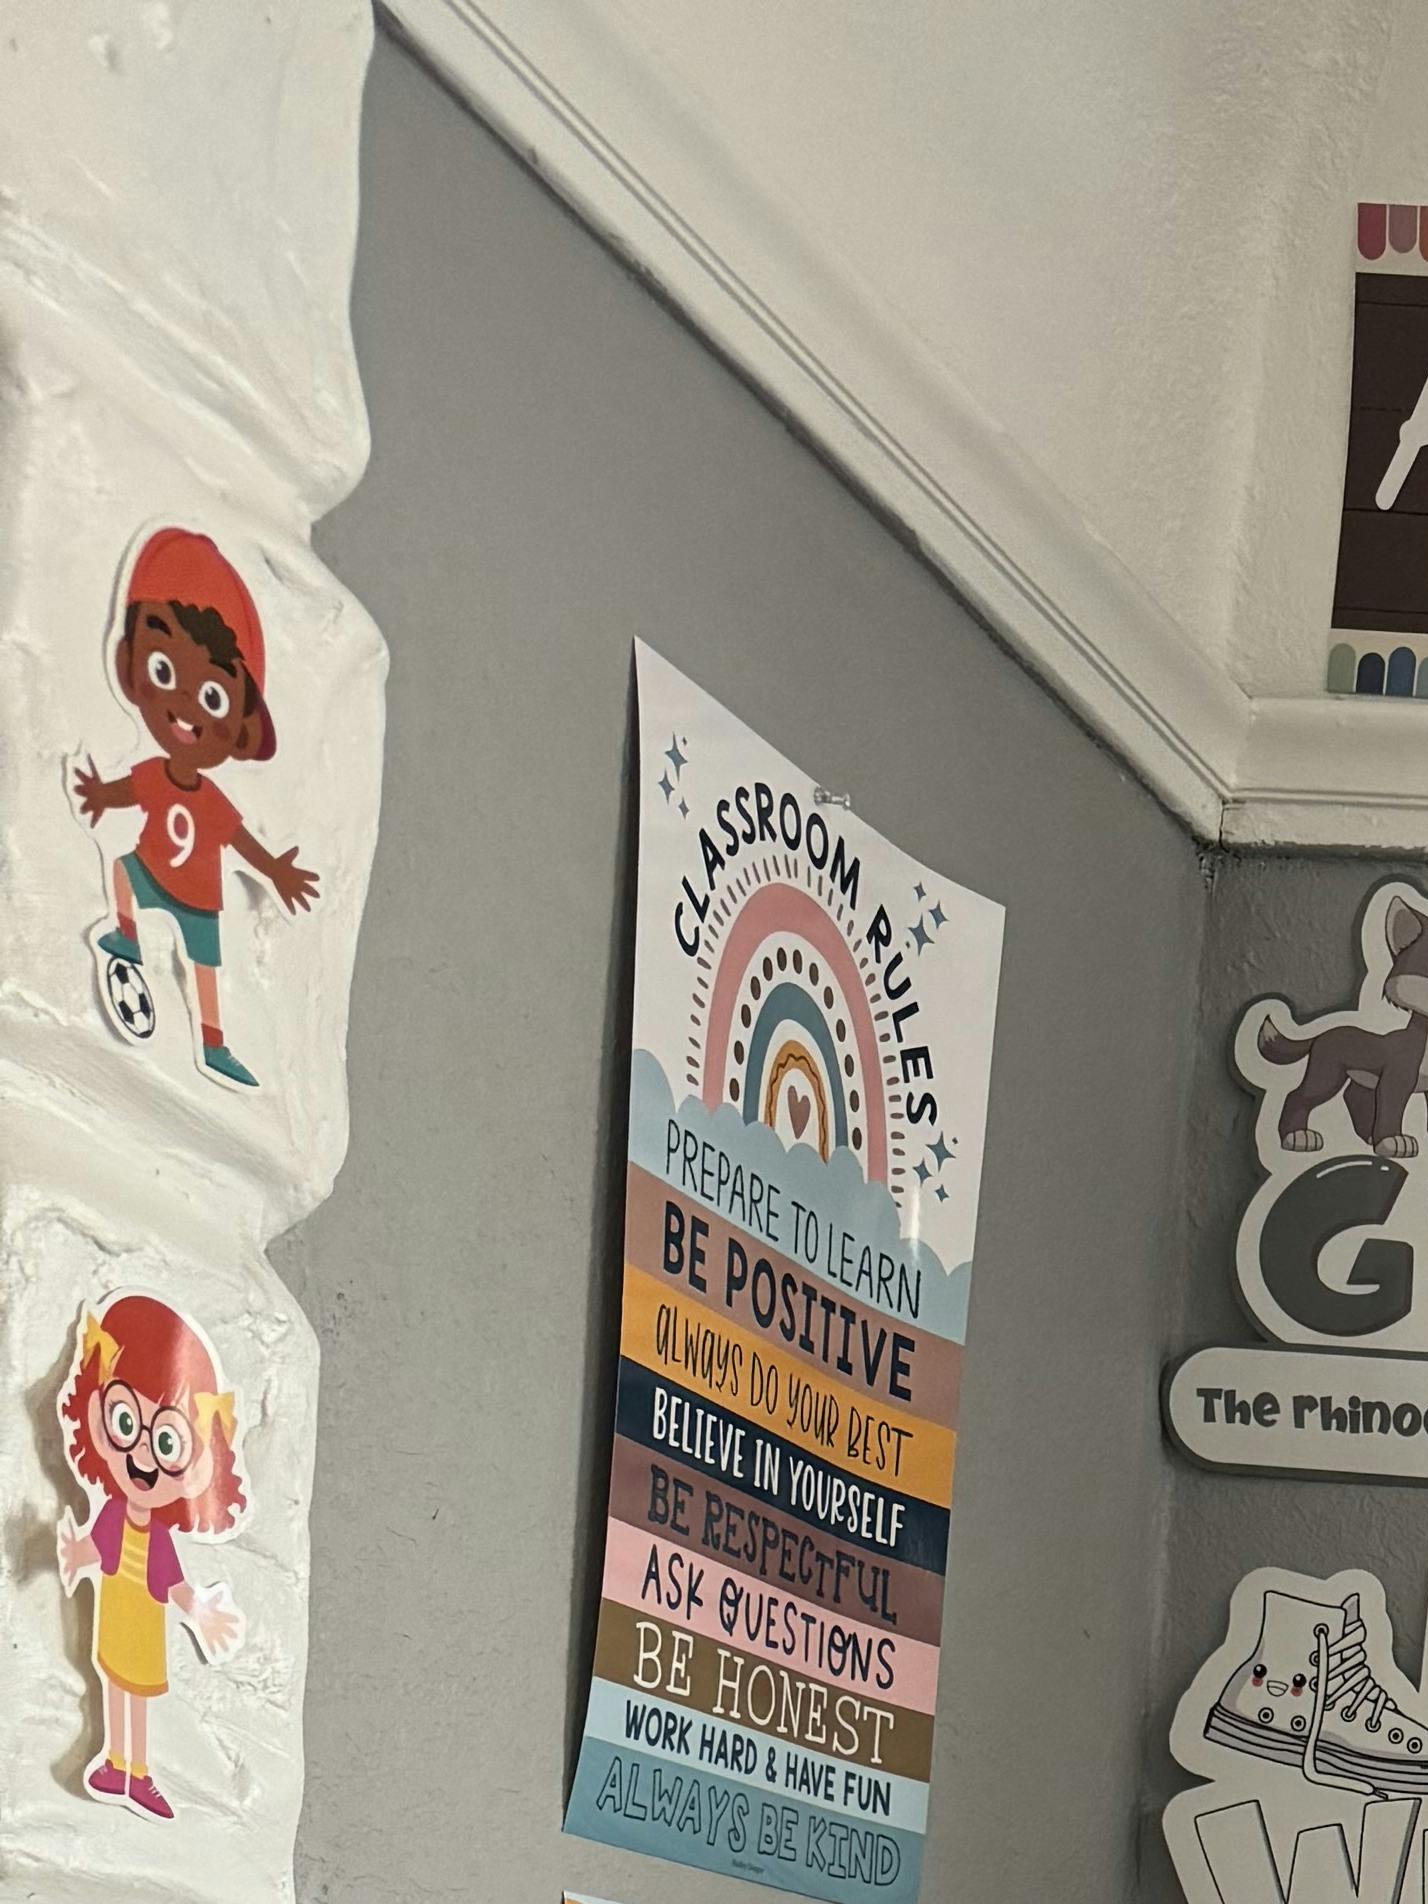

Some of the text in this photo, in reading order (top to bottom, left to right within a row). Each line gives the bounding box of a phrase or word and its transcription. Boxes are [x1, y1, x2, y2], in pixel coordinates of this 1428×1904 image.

[166, 803, 196, 868] 9
[673, 781, 938, 1129] CLASSROOM RULES
[665, 1117, 922, 1320] PREPARE TO LEARN
[663, 1202, 916, 1402] BE POSITIVE
[652, 1386, 905, 1549] BELIEVE IN YOURSELF
[750, 1346, 780, 1416] DO
[847, 1415, 913, 1477] BEST
[1196, 1386, 1280, 1429] The
[642, 1544, 896, 1690] ASK QUESTIONS
[650, 1464, 897, 1625] BE RESPECTFUL
[626, 1700, 891, 1816] WORK HARD & HAVE FUN
[634, 1621, 894, 1766] BE HONEST
[597, 1756, 900, 1887] ALWAYS BE KIND
